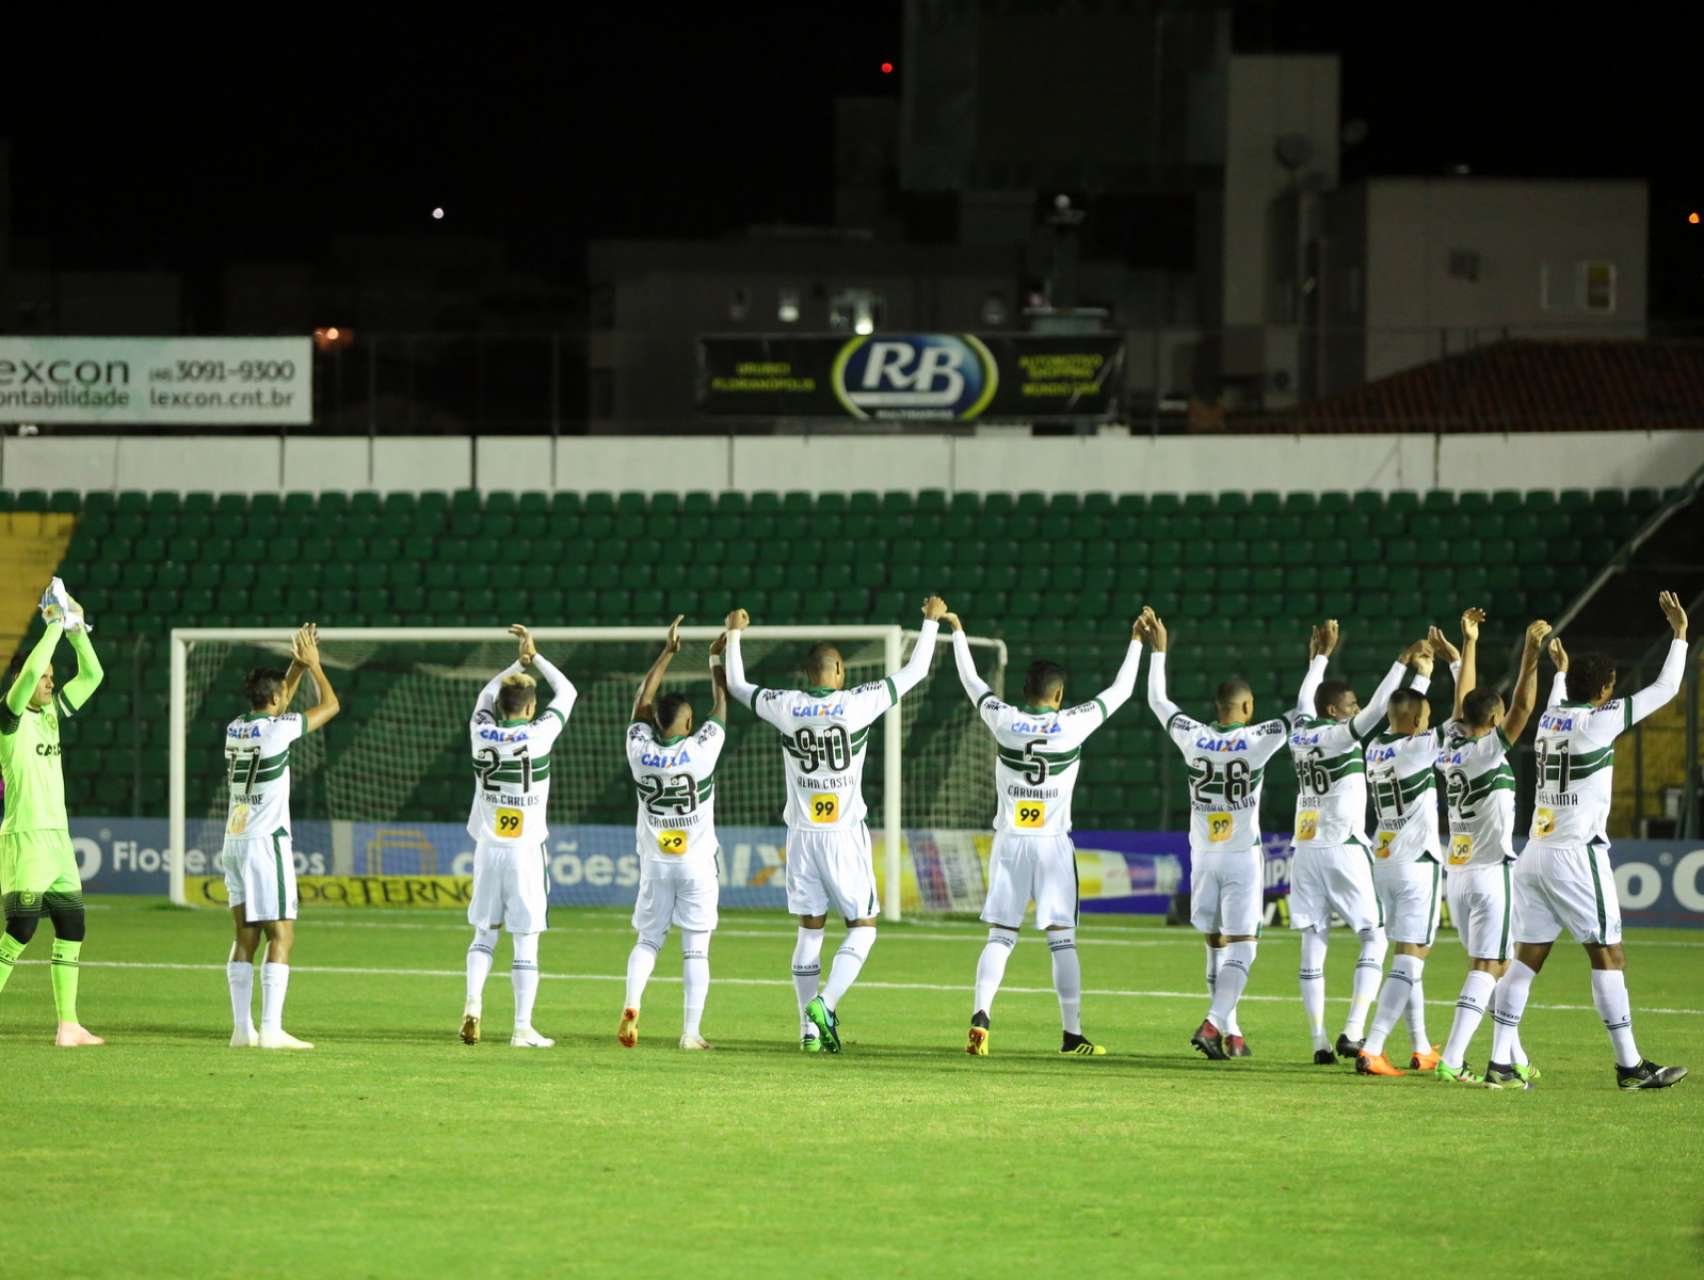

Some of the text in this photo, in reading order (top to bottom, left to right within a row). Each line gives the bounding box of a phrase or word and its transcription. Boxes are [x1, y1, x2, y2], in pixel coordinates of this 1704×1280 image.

[176, 359, 296, 383] 3091-9300
[862, 342, 965, 392] RB
[150, 387, 295, 408] lexcon.cnt.br
[793, 704, 845, 718] CAIXA
[480, 729, 529, 742] CAIXA
[1011, 722, 1062, 734] CAIXA
[795, 724, 851, 774] 90
[1196, 738, 1249, 752] CAIXA
[641, 751, 691, 768] CAIXA
[1024, 738, 1049, 786] 5
[478, 745, 531, 794] 21
[641, 773, 697, 816] 23
[1007, 784, 1059, 799] CARVALHO
[815, 801, 835, 817] 99
[1019, 807, 1041, 822] 99
[499, 815, 519, 830] 99
